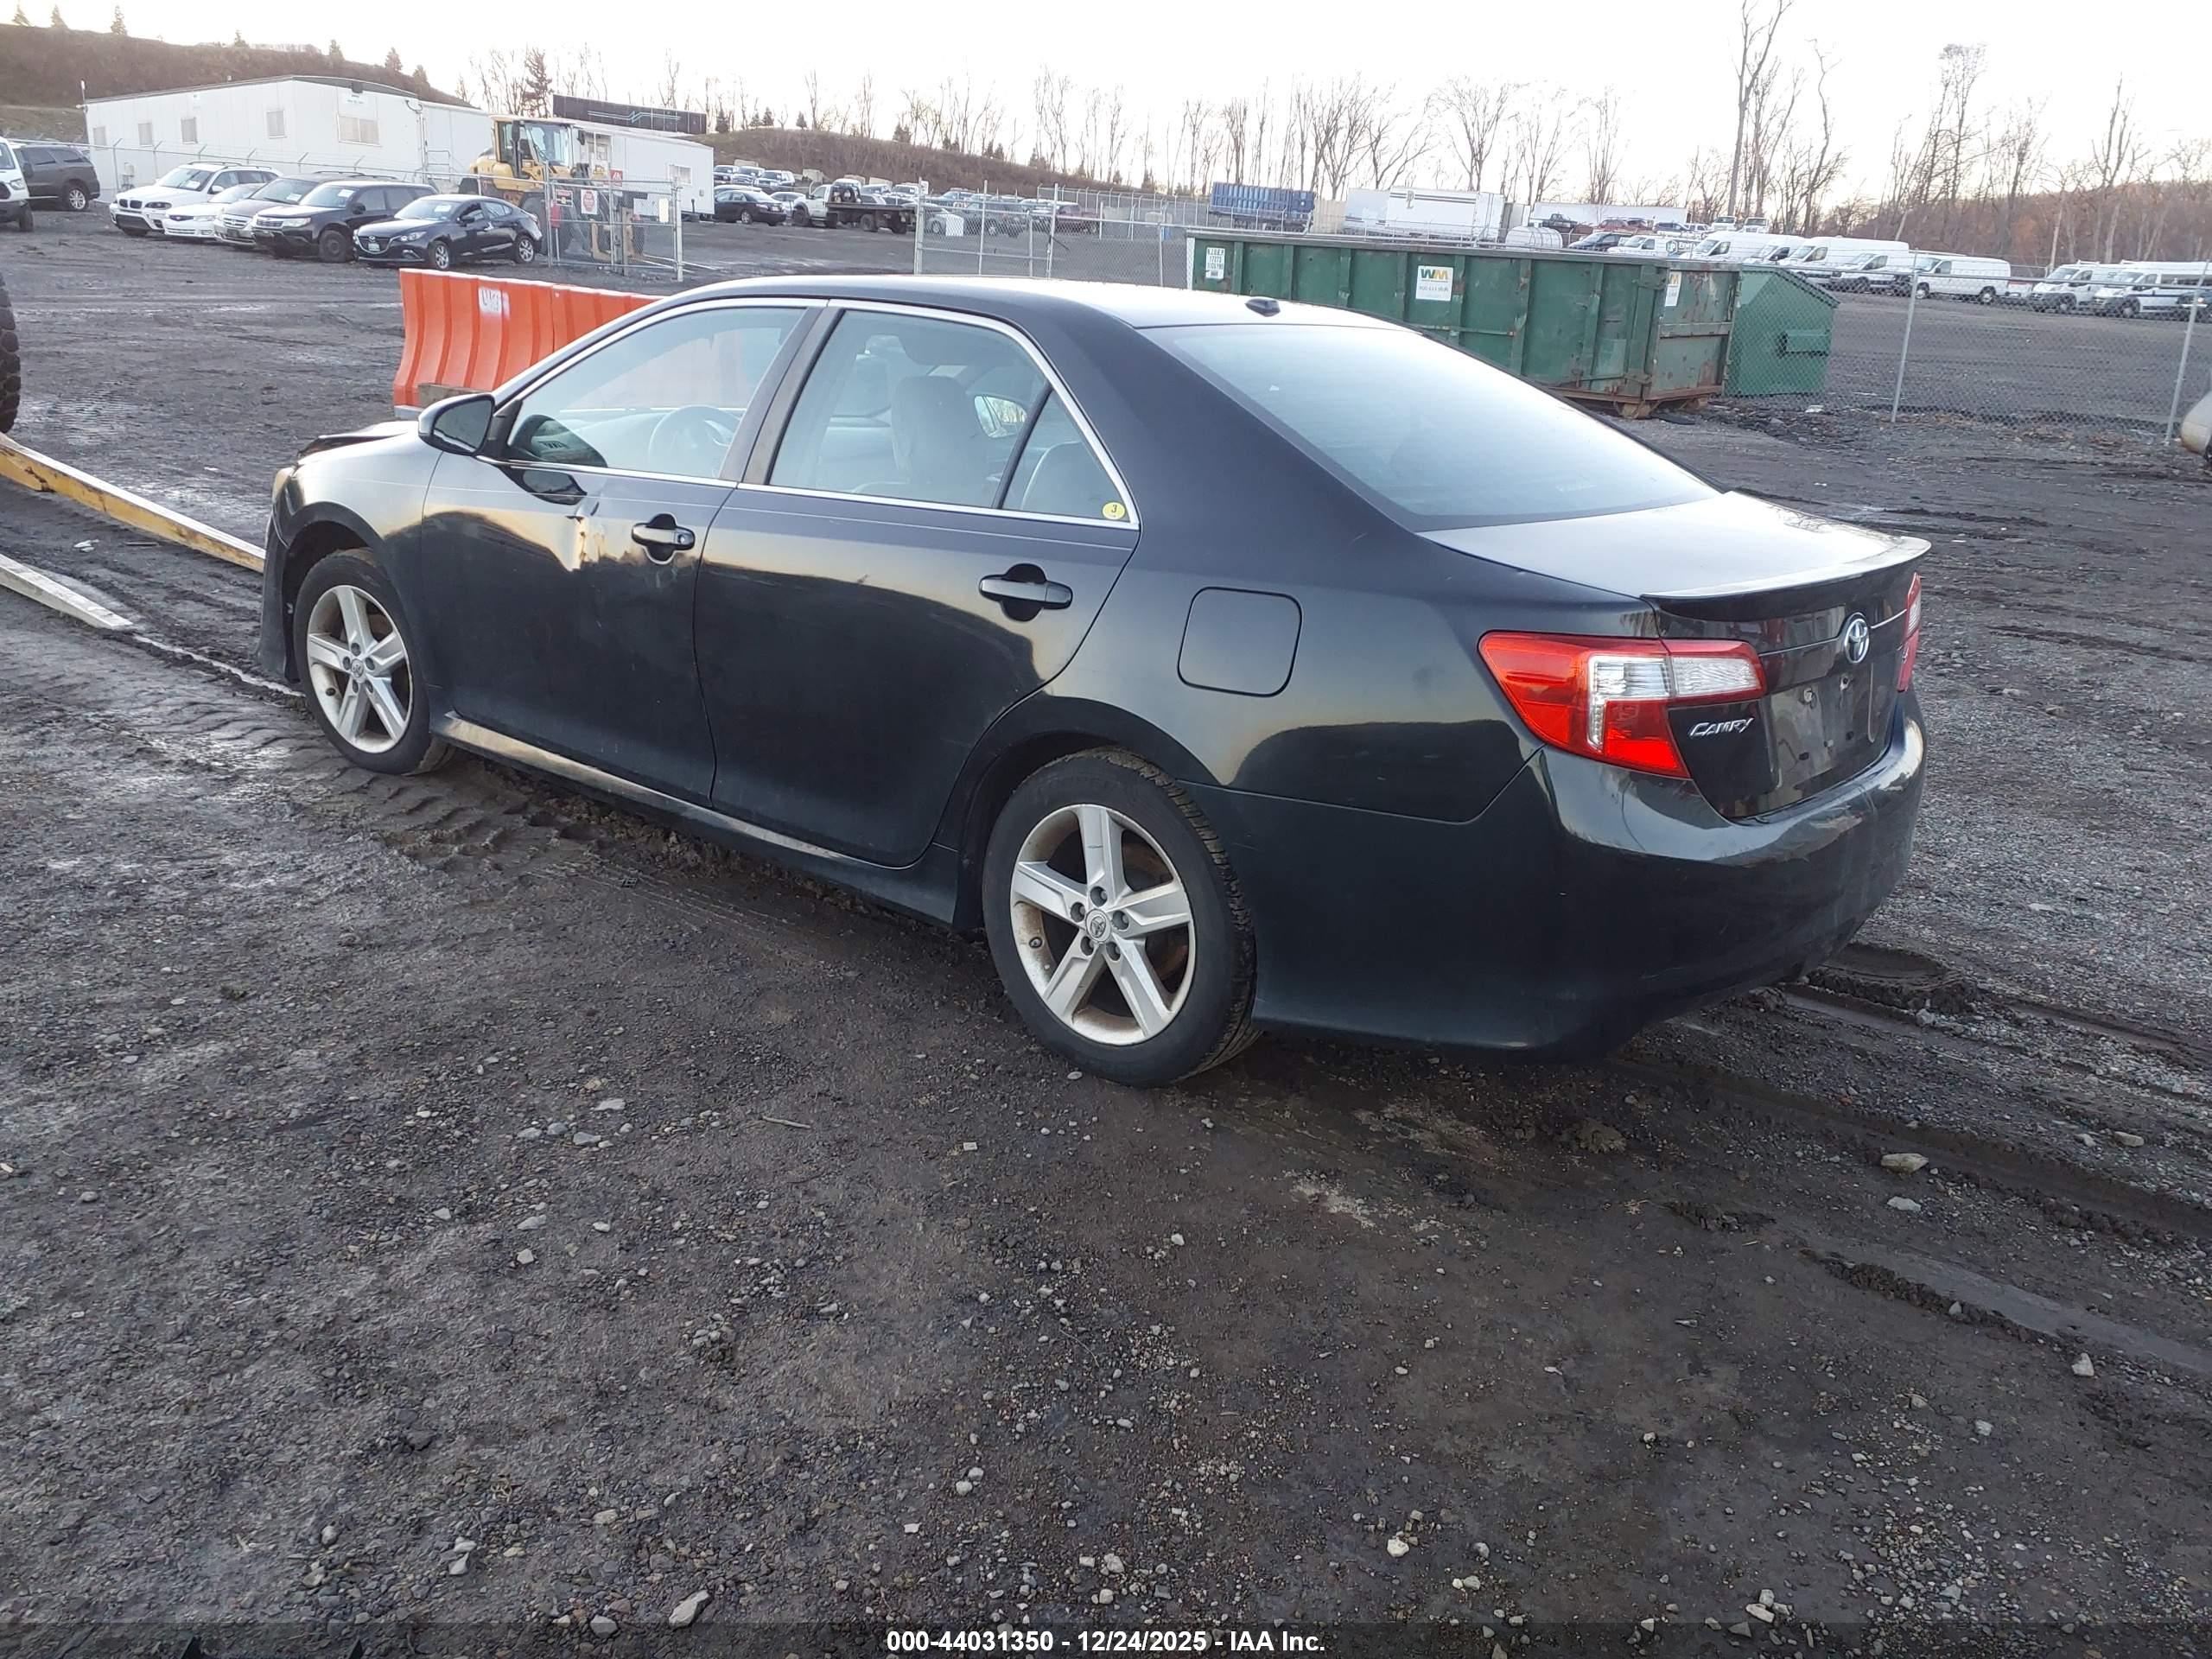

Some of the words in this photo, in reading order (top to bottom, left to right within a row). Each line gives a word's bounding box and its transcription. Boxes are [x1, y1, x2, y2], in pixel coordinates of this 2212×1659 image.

[1421, 268, 1448, 280] WM
[1111, 504, 1118, 513] 3
[1689, 717, 1754, 737] CAMRY
